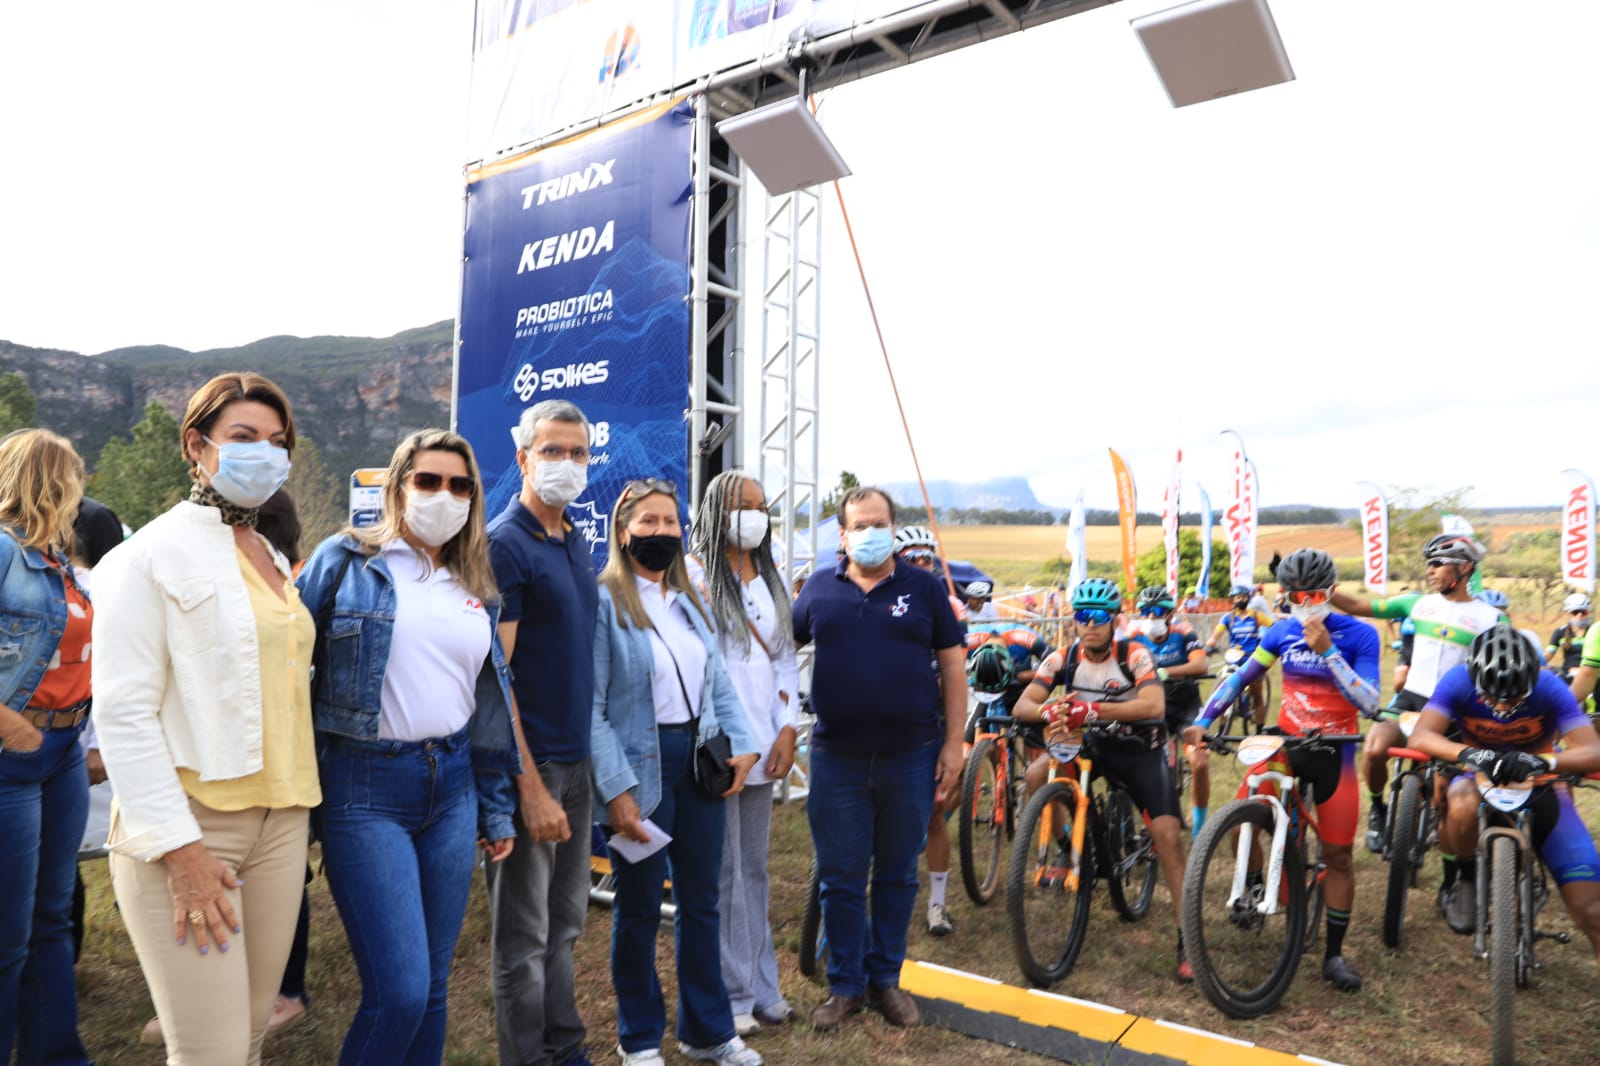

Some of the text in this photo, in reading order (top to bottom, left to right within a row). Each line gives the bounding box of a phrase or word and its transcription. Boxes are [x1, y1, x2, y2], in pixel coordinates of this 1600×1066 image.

[521, 159, 616, 210] TRINX
[517, 220, 615, 275] KENDA
[515, 311, 614, 339] MAKE YOURSELF EPIC
[516, 289, 613, 328] PROBIOTICA
